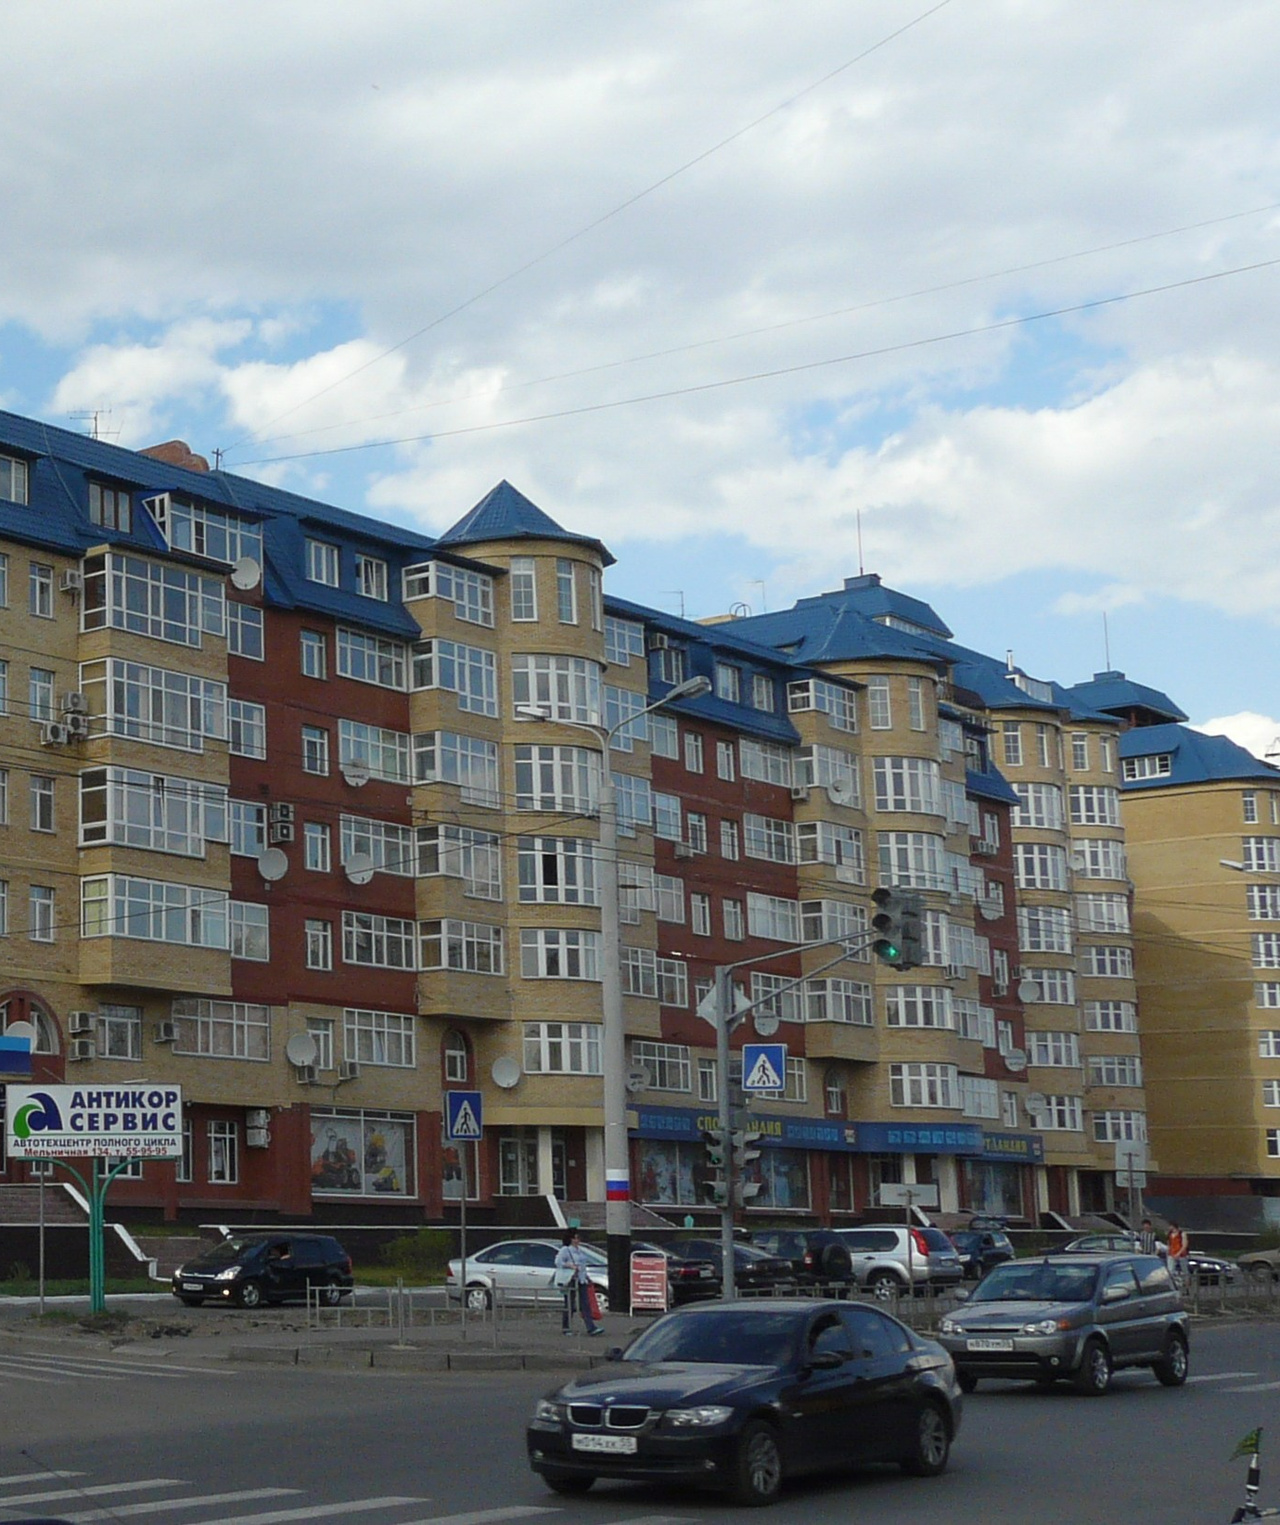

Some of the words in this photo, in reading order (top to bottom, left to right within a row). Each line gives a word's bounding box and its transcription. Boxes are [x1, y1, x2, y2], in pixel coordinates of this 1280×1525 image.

[70, 1091, 178, 1109] АНТИКОР
[70, 1112, 176, 1131] СЕРВИС
[13, 1139, 91, 1148] АВТОТЕХЦЕНТР
[94, 1138, 140, 1147] ПОЛНОГО
[143, 1138, 176, 1147] ЦИКЛА
[24, 1148, 88, 1157] Мельничная
[126, 1147, 168, 1156] 55-95-95
